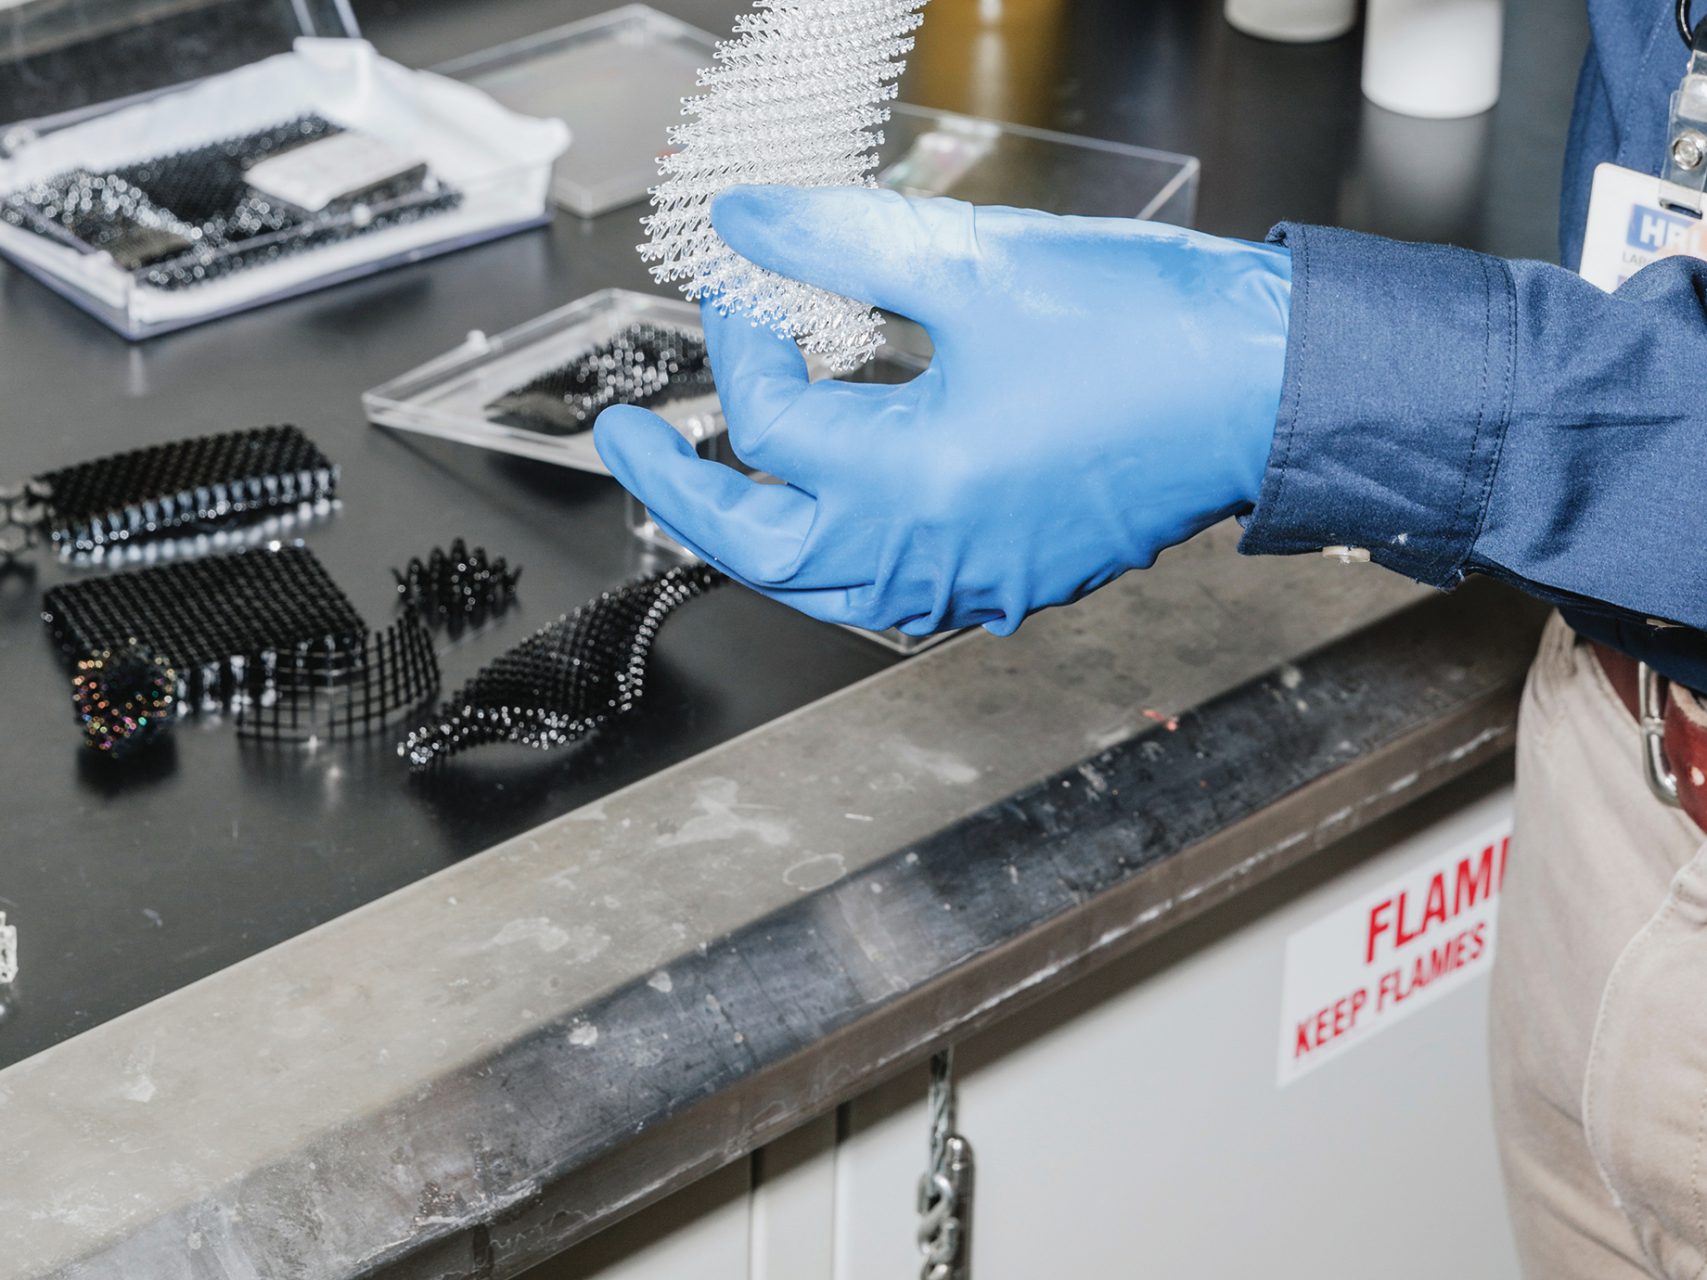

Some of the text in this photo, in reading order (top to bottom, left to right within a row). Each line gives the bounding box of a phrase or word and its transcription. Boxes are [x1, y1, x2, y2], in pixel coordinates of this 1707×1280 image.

[1366, 836, 1510, 965] FLAM
[1295, 988, 1367, 1057] KEEP
[1377, 923, 1485, 1011] FLAMES
